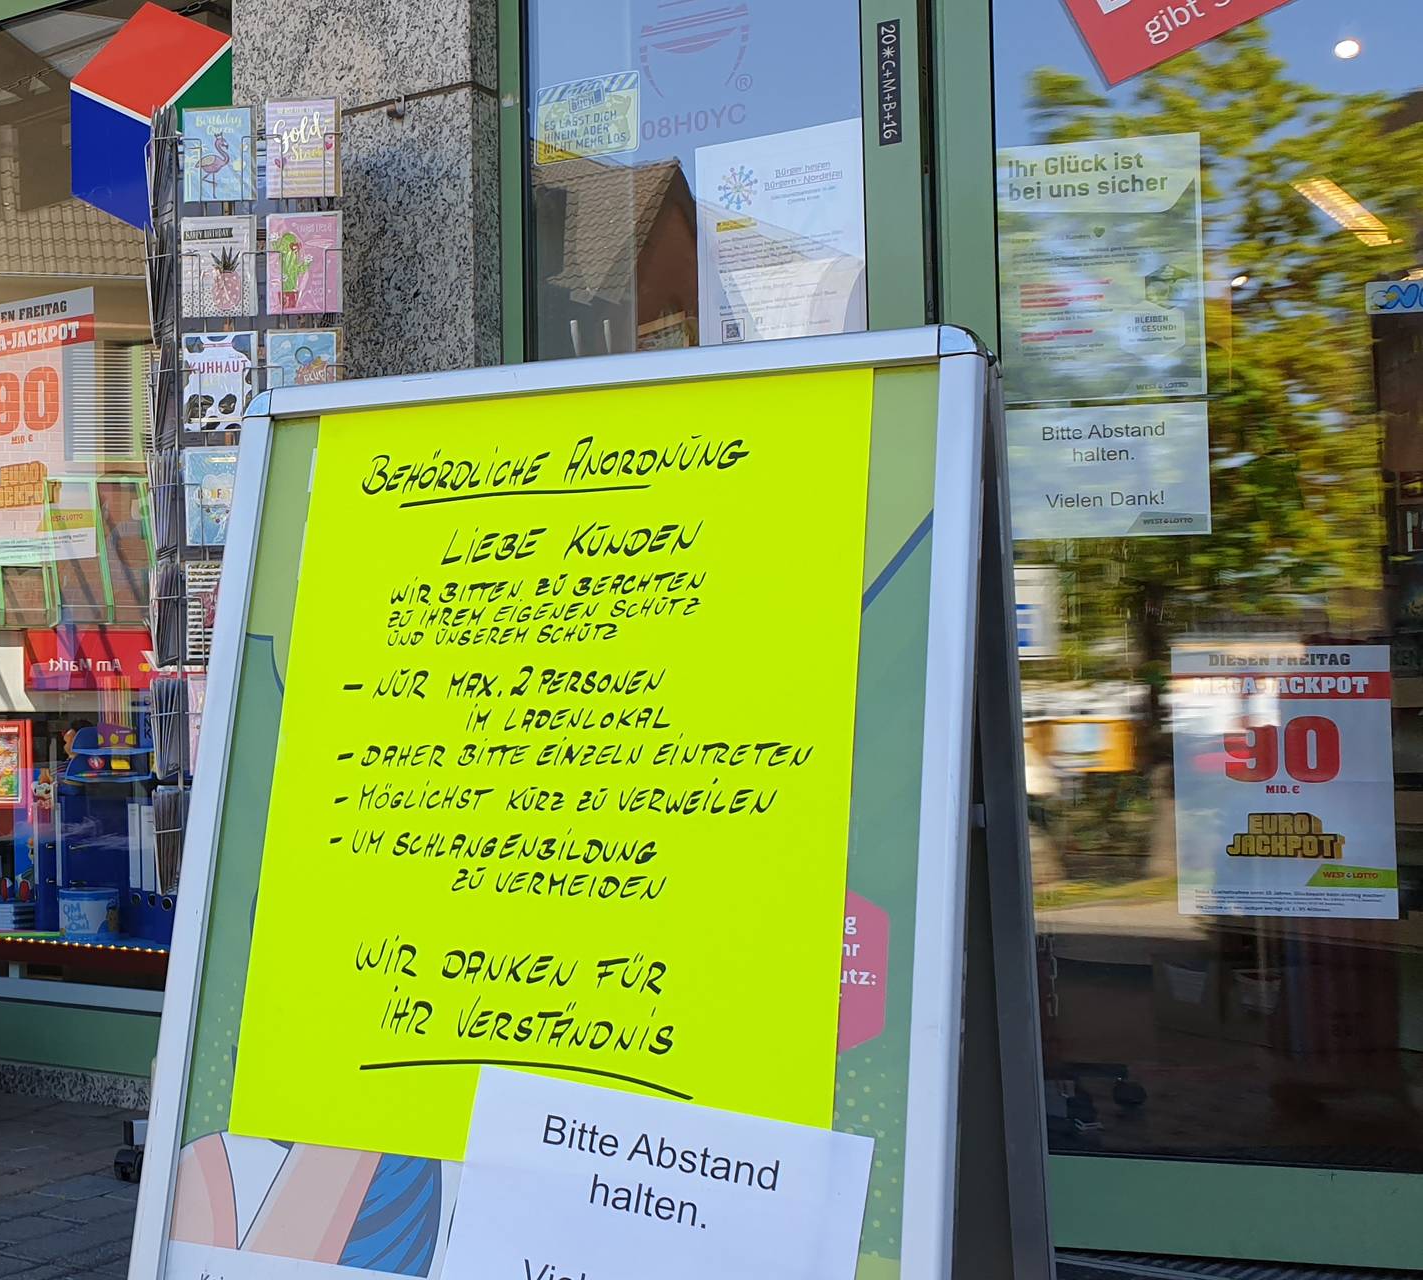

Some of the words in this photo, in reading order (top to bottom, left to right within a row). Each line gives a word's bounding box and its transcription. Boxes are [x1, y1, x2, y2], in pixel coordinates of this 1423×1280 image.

[1145, 0, 1205, 45] gibt
[593, 110, 617, 123] DICH
[576, 134, 603, 150] MEHR
[1008, 160, 1037, 178] Ihr
[1044, 154, 1107, 175] Glück
[1114, 152, 1144, 170] ist
[1009, 181, 1041, 201] bei
[1049, 184, 1090, 198] uns
[1097, 174, 1168, 195] sicher
[18, 300, 68, 320] FREITAG
[1041, 426, 1083, 441] Bitte
[1088, 421, 1166, 438] Abstand
[1072, 447, 1135, 463] halten.
[361, 446, 551, 495] BEHÖRDLICHE
[1045, 493, 1103, 509] Vielen
[1110, 490, 1165, 506] Dank!
[441, 526, 547, 566] LIEBE
[389, 577, 431, 606] WIR
[438, 579, 524, 604] BITTEN
[424, 603, 482, 628] IHREM
[493, 601, 599, 624] EIGENEN
[1208, 654, 1270, 666] DIESEN
[1276, 653, 1351, 666] FREITAG
[509, 666, 535, 697] 2
[537, 667, 666, 696] PERSONEN
[465, 703, 492, 732] IM
[503, 706, 672, 733] LADENLOKAL
[360, 743, 446, 768] DAHER
[457, 736, 532, 768] BITTE
[535, 736, 646, 768] EINZELN
[652, 732, 816, 769] EINTRETEN
[1223, 715, 1341, 784] 90
[358, 779, 495, 812] MÖGLICHST
[617, 776, 780, 816] VERWEILEN
[1265, 785, 1291, 795] MIO.
[1291, 785, 1300, 794] €
[1248, 812, 1315, 835] EURO
[351, 828, 382, 856] UM
[391, 826, 658, 865] SCHLANGENBILDUNG
[1226, 833, 1341, 859] JACKPOT
[495, 871, 667, 901] VERMEIDEN
[355, 934, 419, 978] WIR
[441, 949, 580, 988] DANKEN
[596, 951, 668, 996] FÜR
[380, 984, 434, 1036] IHR
[456, 994, 675, 1056] VERSTÄNDNIS
[542, 1114, 620, 1157] Bitte
[626, 1132, 781, 1191] Abstand
[589, 1173, 707, 1230] halten.
